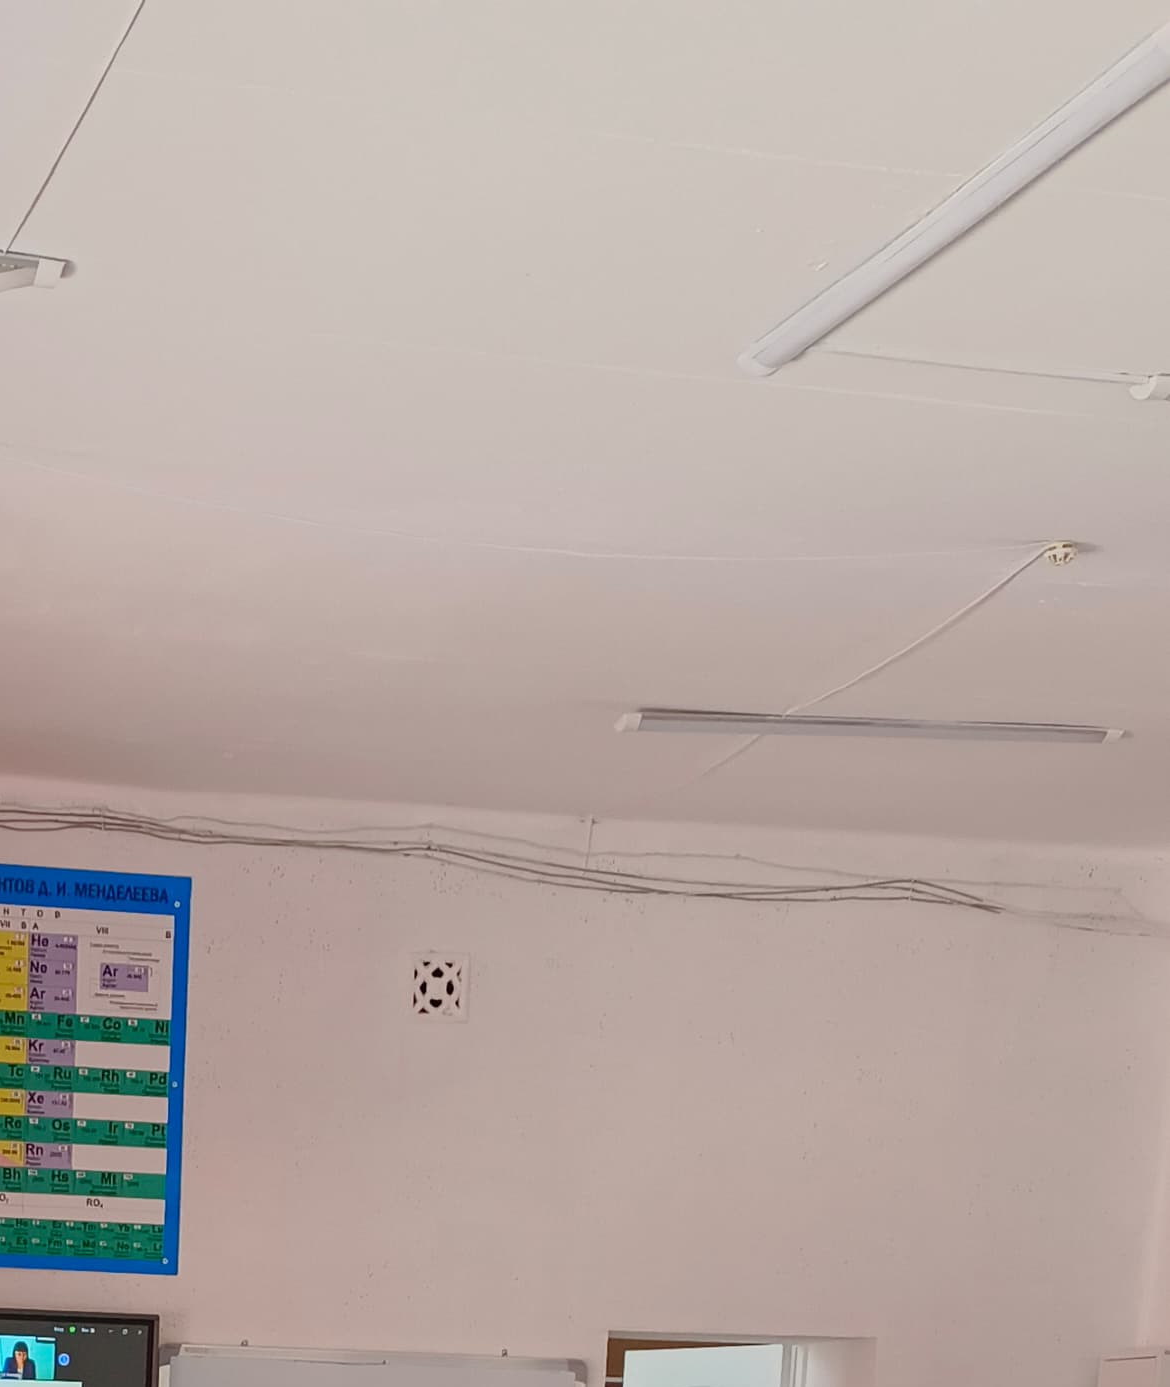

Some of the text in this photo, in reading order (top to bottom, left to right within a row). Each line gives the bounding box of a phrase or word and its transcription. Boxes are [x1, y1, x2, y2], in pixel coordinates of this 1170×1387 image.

[38, 881, 52, 897] Д.
[56, 883, 69, 897] И.
[74, 883, 169, 903] МЕНДЕЛЕЕВА
[30, 961, 48, 973] Ne
[102, 965, 119, 978] Ar
[29, 987, 46, 1000] Ar
[4, 1012, 24, 1024] Mn
[57, 1014, 73, 1027] Fe
[28, 1039, 45, 1051] Kr
[53, 1067, 72, 1080] Ru
[101, 1070, 119, 1082] Rh
[149, 1072, 167, 1085] Pd
[28, 1092, 45, 1105] Xe
[52, 1119, 70, 1131] Os
[108, 1122, 119, 1134] Ir
[152, 1124, 166, 1137] Pt
[26, 1144, 44, 1156] Rn
[2, 1167, 21, 1180] Bh
[51, 1170, 69, 1182] Hs
[101, 1172, 117, 1185] Mt
